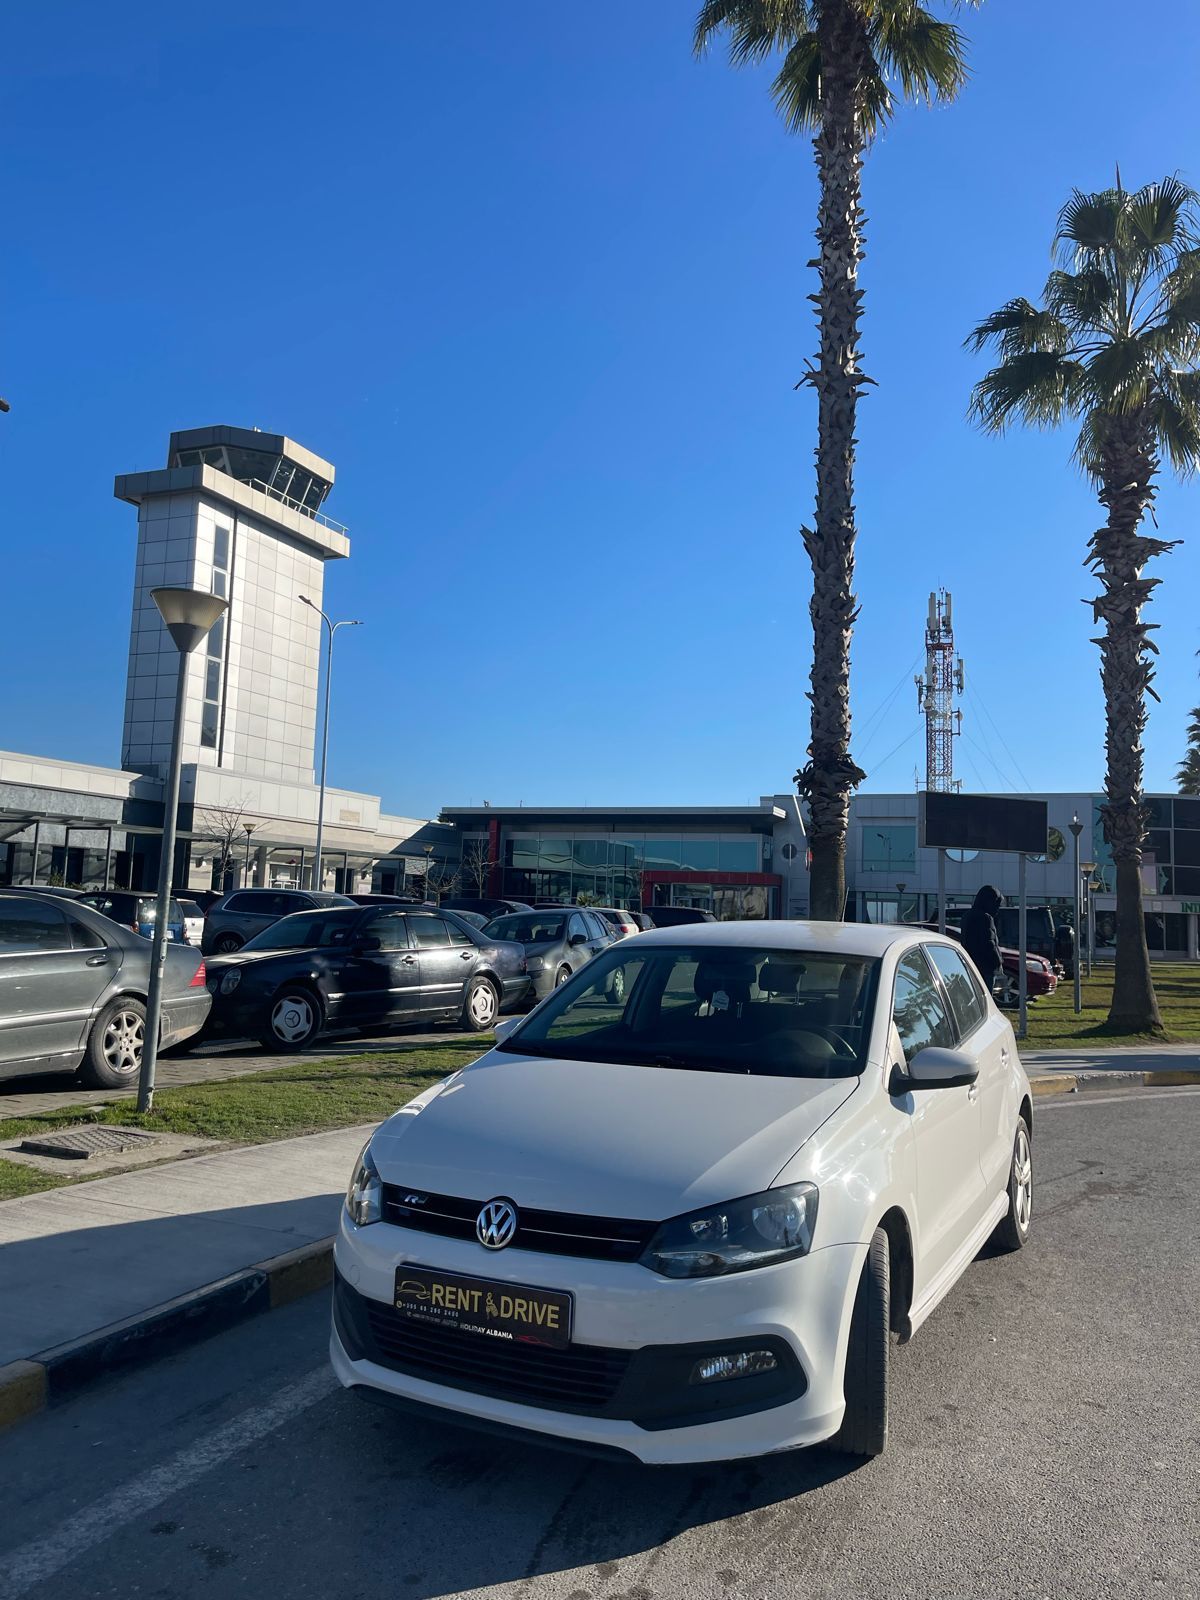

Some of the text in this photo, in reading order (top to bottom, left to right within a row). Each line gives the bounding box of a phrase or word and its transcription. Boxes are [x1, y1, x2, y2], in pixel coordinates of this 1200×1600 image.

[432, 1284, 482, 1313] RENT
[500, 1296, 559, 1328] DRIVE
[460, 1323, 485, 1333] HOLIDAY
[486, 1329, 513, 1339] ALBANIA
